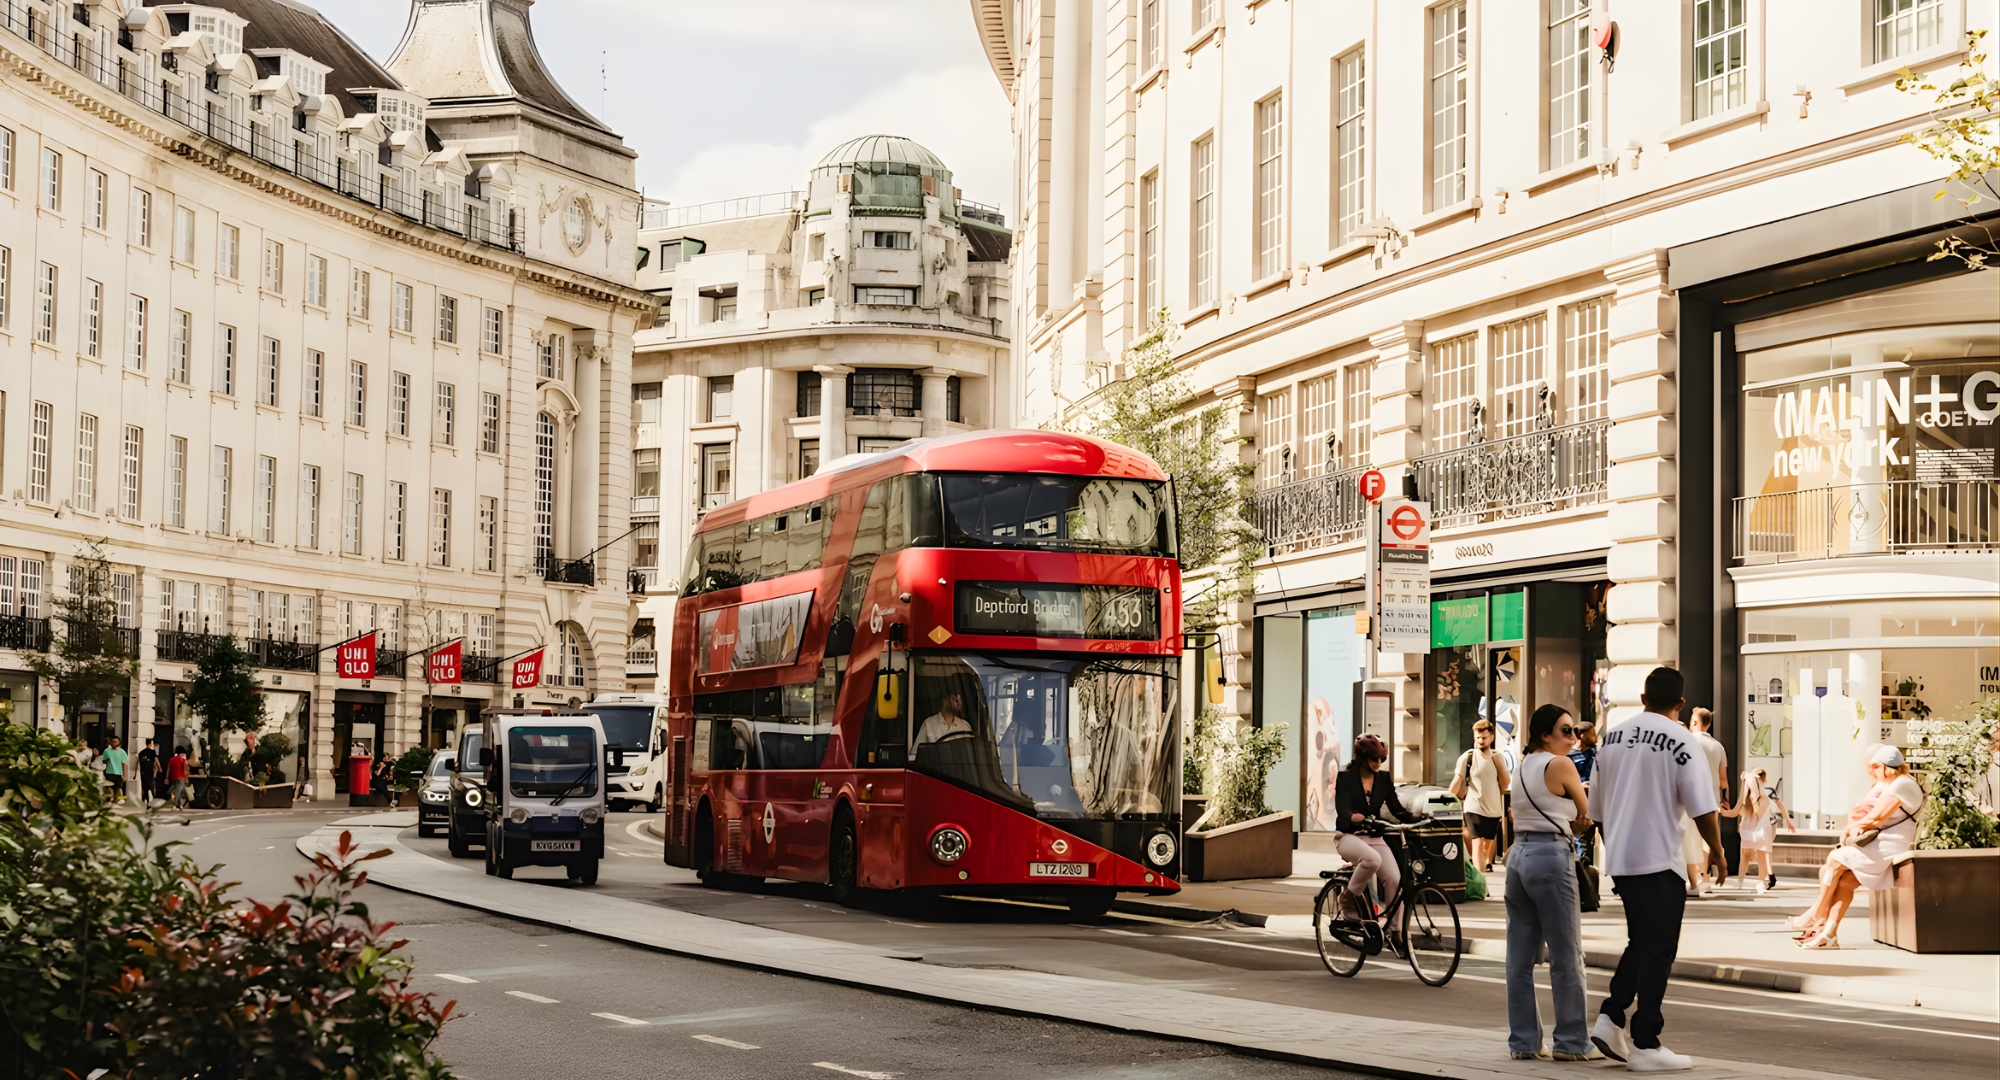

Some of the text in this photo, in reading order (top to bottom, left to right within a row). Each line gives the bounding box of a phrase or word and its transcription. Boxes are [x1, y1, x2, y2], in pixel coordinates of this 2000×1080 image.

[1774, 445, 1823, 478] new
[1366, 474, 1380, 496] F
[975, 596, 1028, 618] Deptford
[343, 648, 367, 660] UNI
[432, 654, 454, 667] UNI
[344, 661, 369, 675] QLO
[432, 667, 455, 681] QLO
[517, 661, 535, 673] UNI
[1626, 726, 1692, 766] Angels
